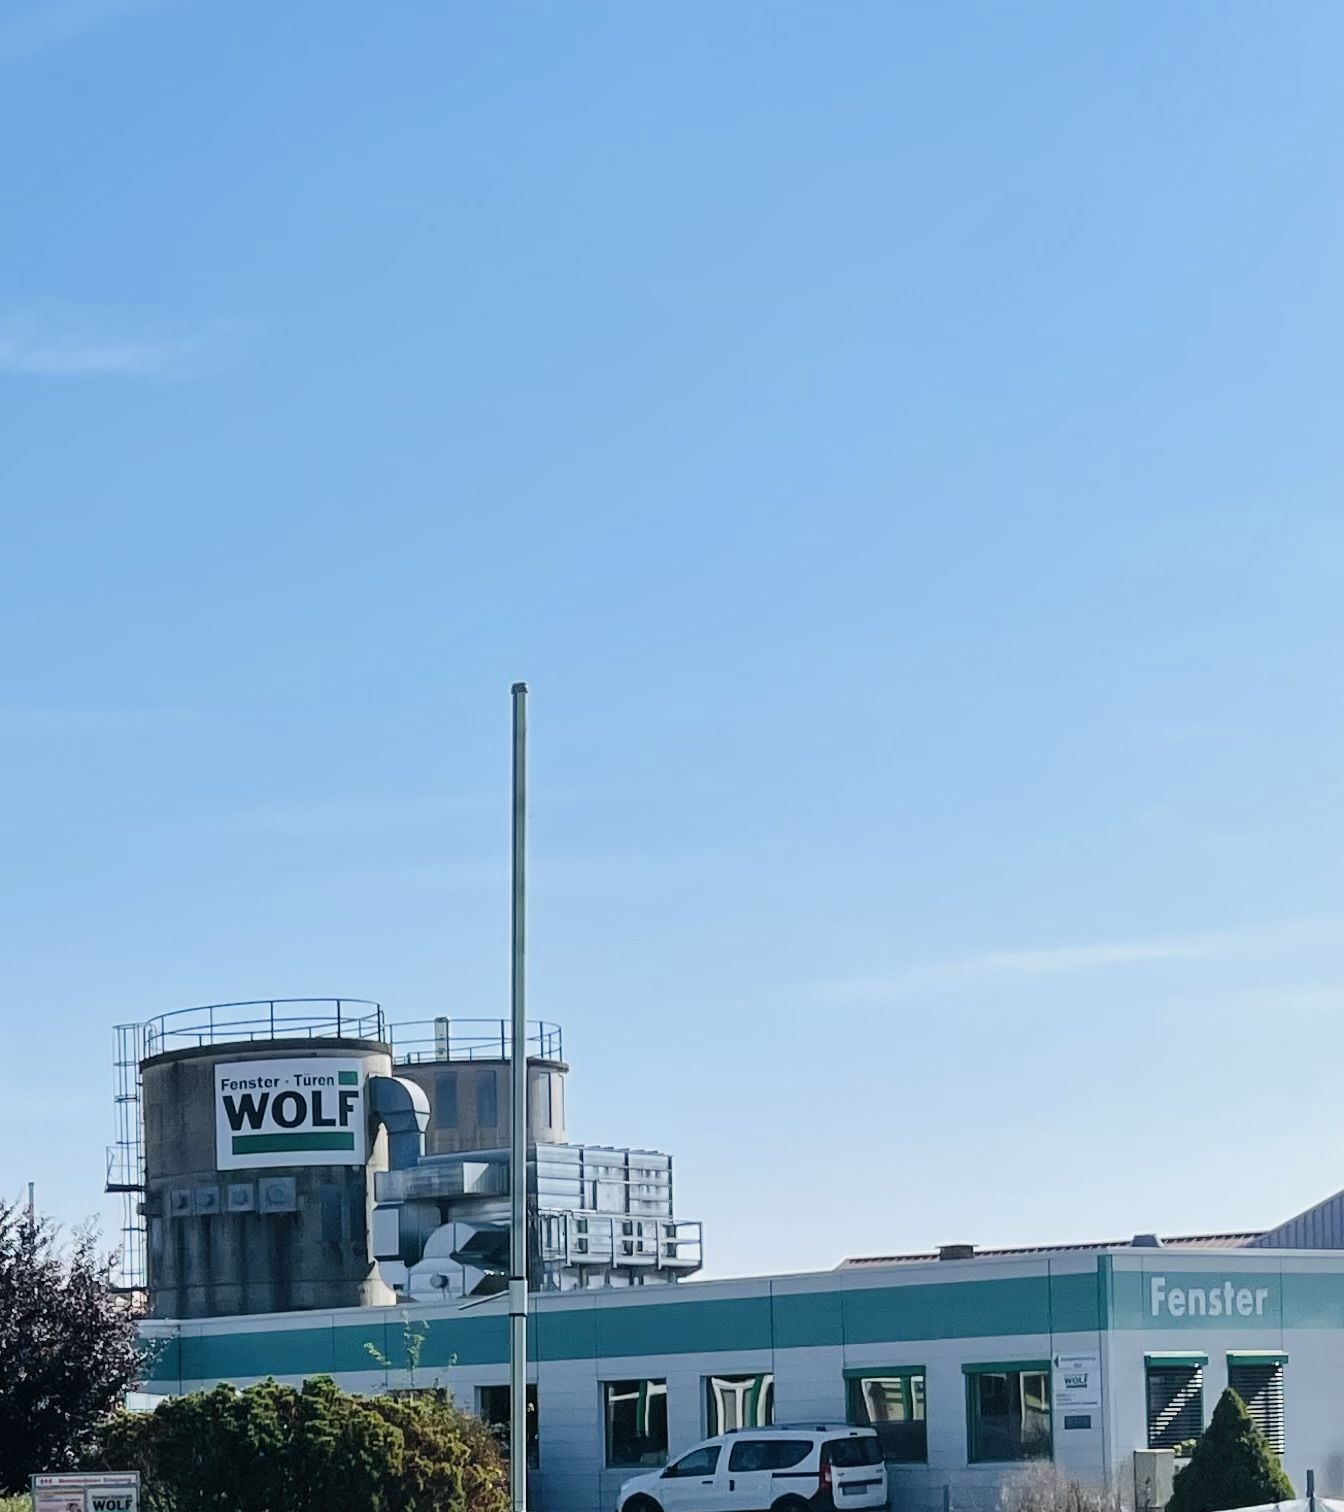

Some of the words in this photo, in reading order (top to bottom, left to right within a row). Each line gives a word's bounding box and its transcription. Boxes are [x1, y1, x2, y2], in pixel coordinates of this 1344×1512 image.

[220, 1077, 280, 1091] Fenster
[293, 1073, 335, 1086] Türen
[222, 1090, 360, 1131] WOLF
[1150, 1276, 1269, 1317] Fenster
[93, 1499, 133, 1511] WOLF
